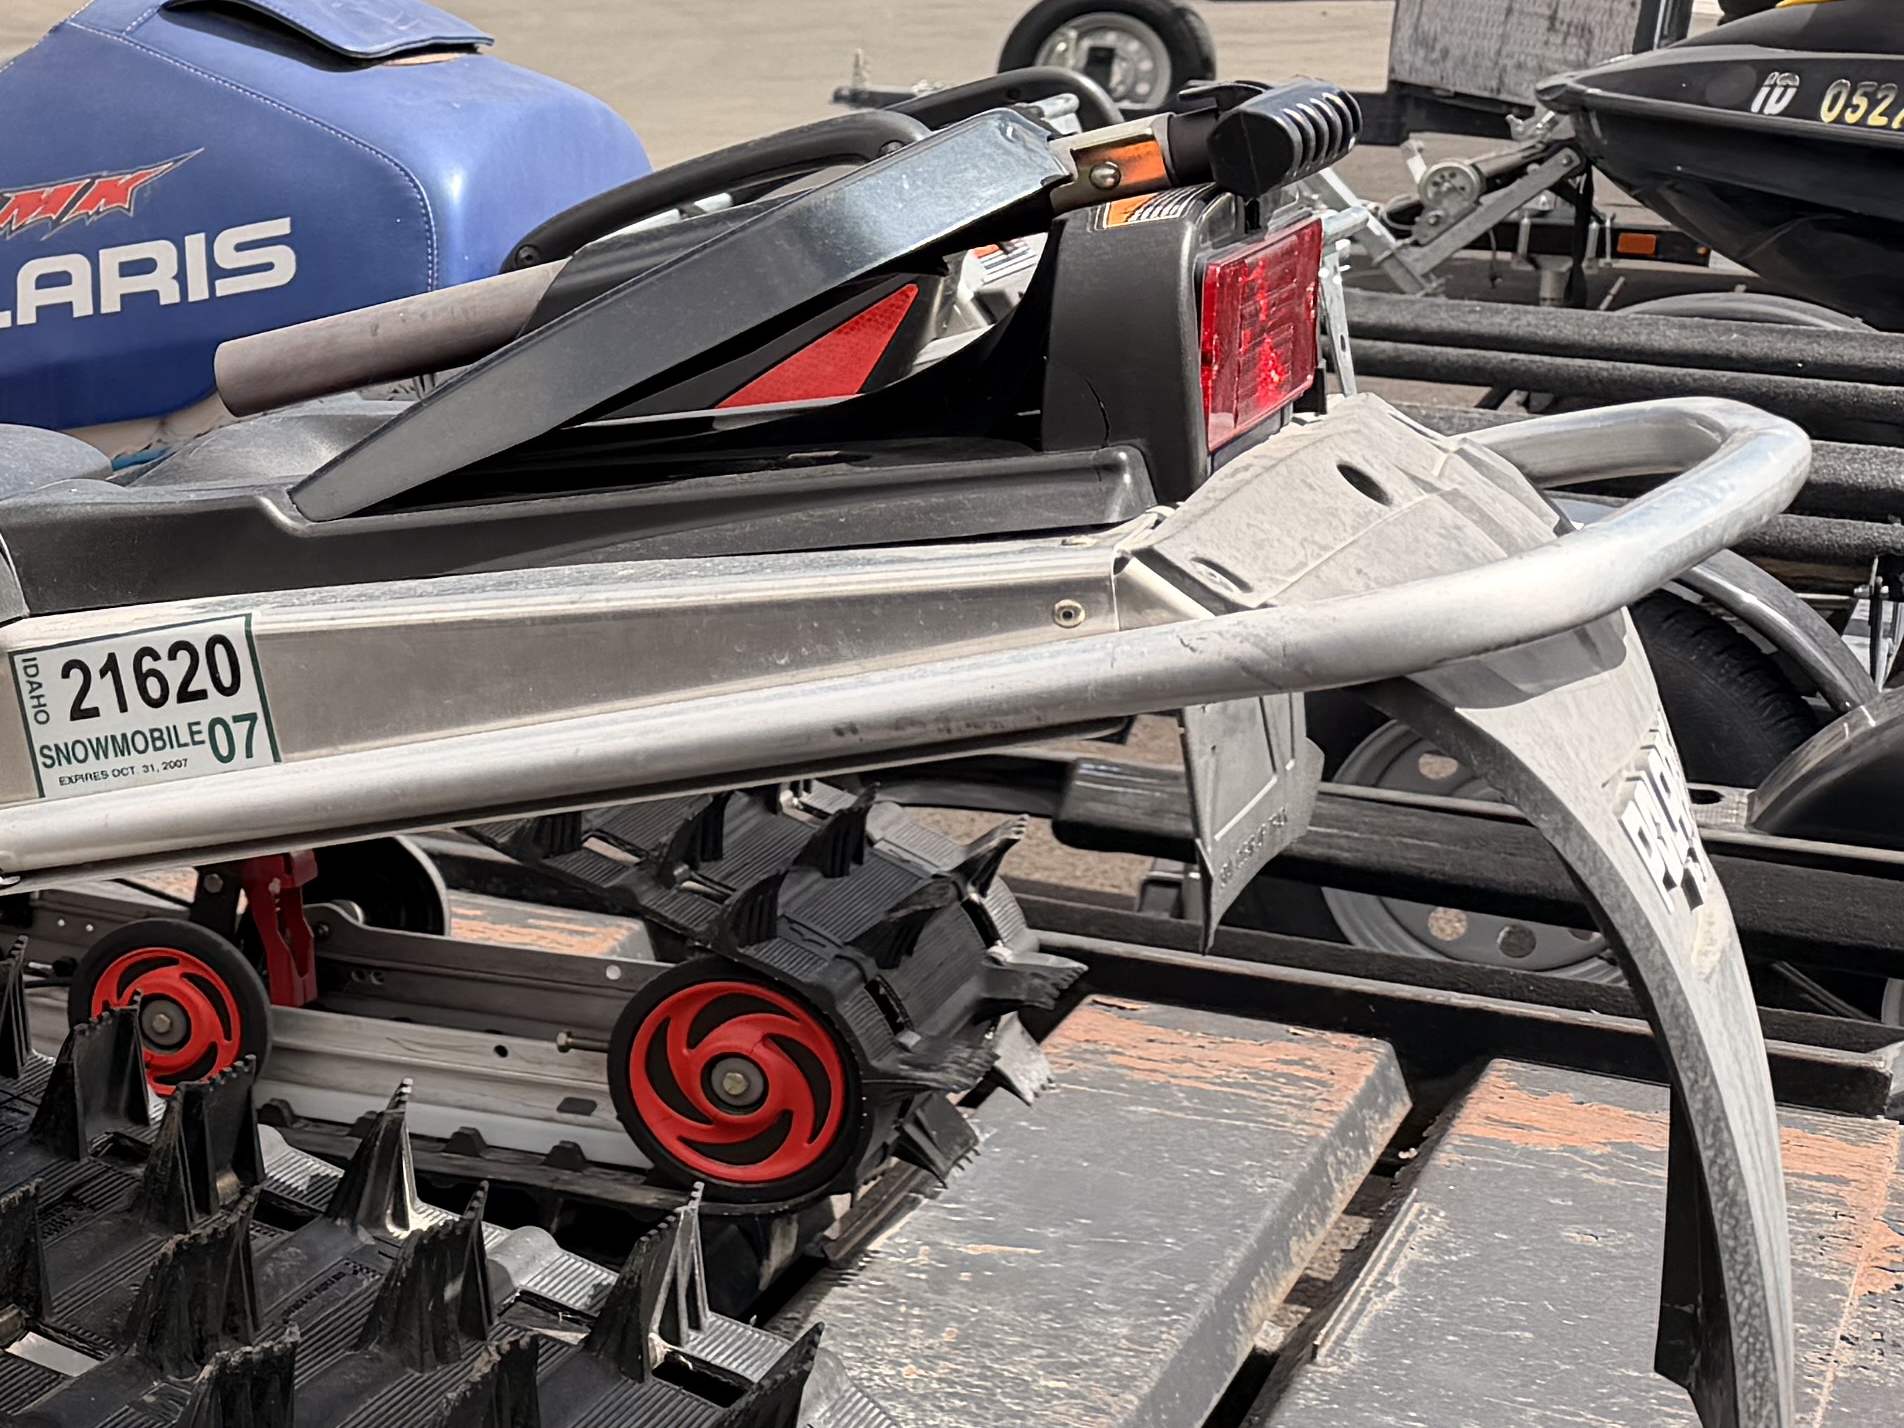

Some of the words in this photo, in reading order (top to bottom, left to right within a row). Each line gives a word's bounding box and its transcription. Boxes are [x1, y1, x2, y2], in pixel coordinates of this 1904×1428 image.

[21, 656, 51, 726] IDAHO
[60, 633, 242, 722] 21620
[39, 720, 206, 769] SNOWMOBILE
[207, 712, 259, 764] 07
[58, 770, 110, 787] EXPIRES
[161, 758, 189, 771] 2007
